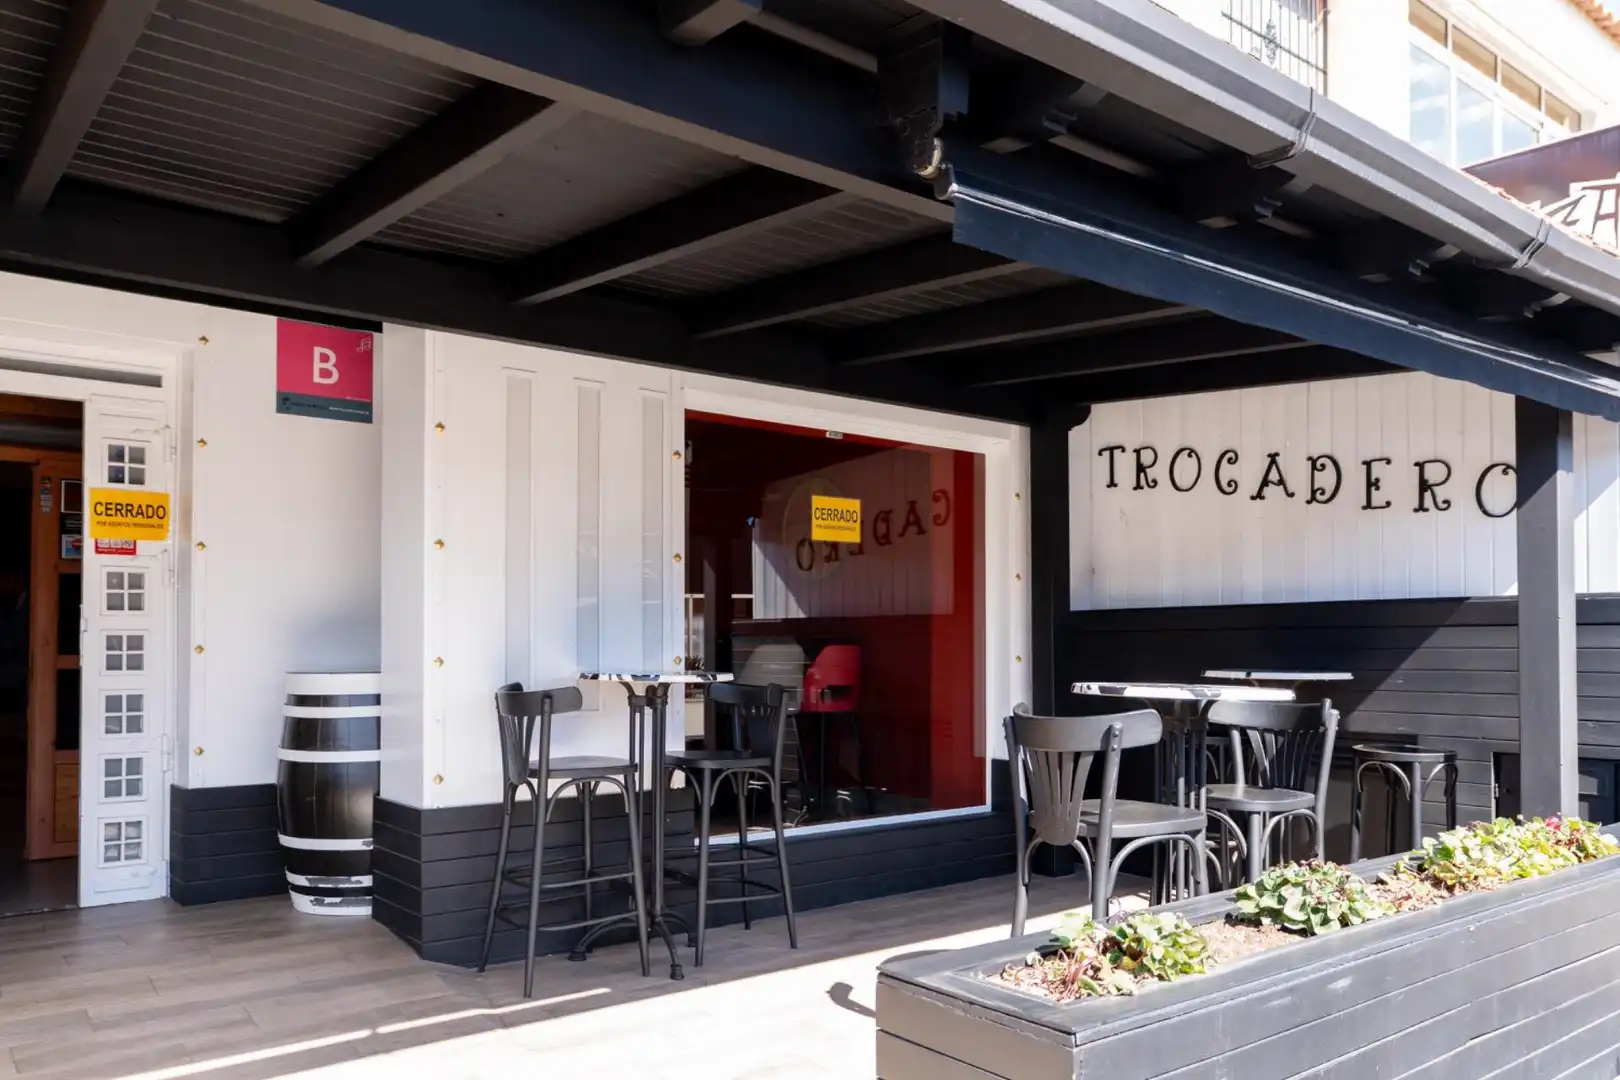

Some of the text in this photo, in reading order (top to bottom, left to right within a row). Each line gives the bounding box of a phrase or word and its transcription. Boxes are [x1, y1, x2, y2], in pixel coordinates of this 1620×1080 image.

[312, 345, 340, 385] B
[1097, 444, 1518, 518] TROCADERO
[93, 501, 167, 520] CERRADO
[813, 507, 859, 523] CERRADO
